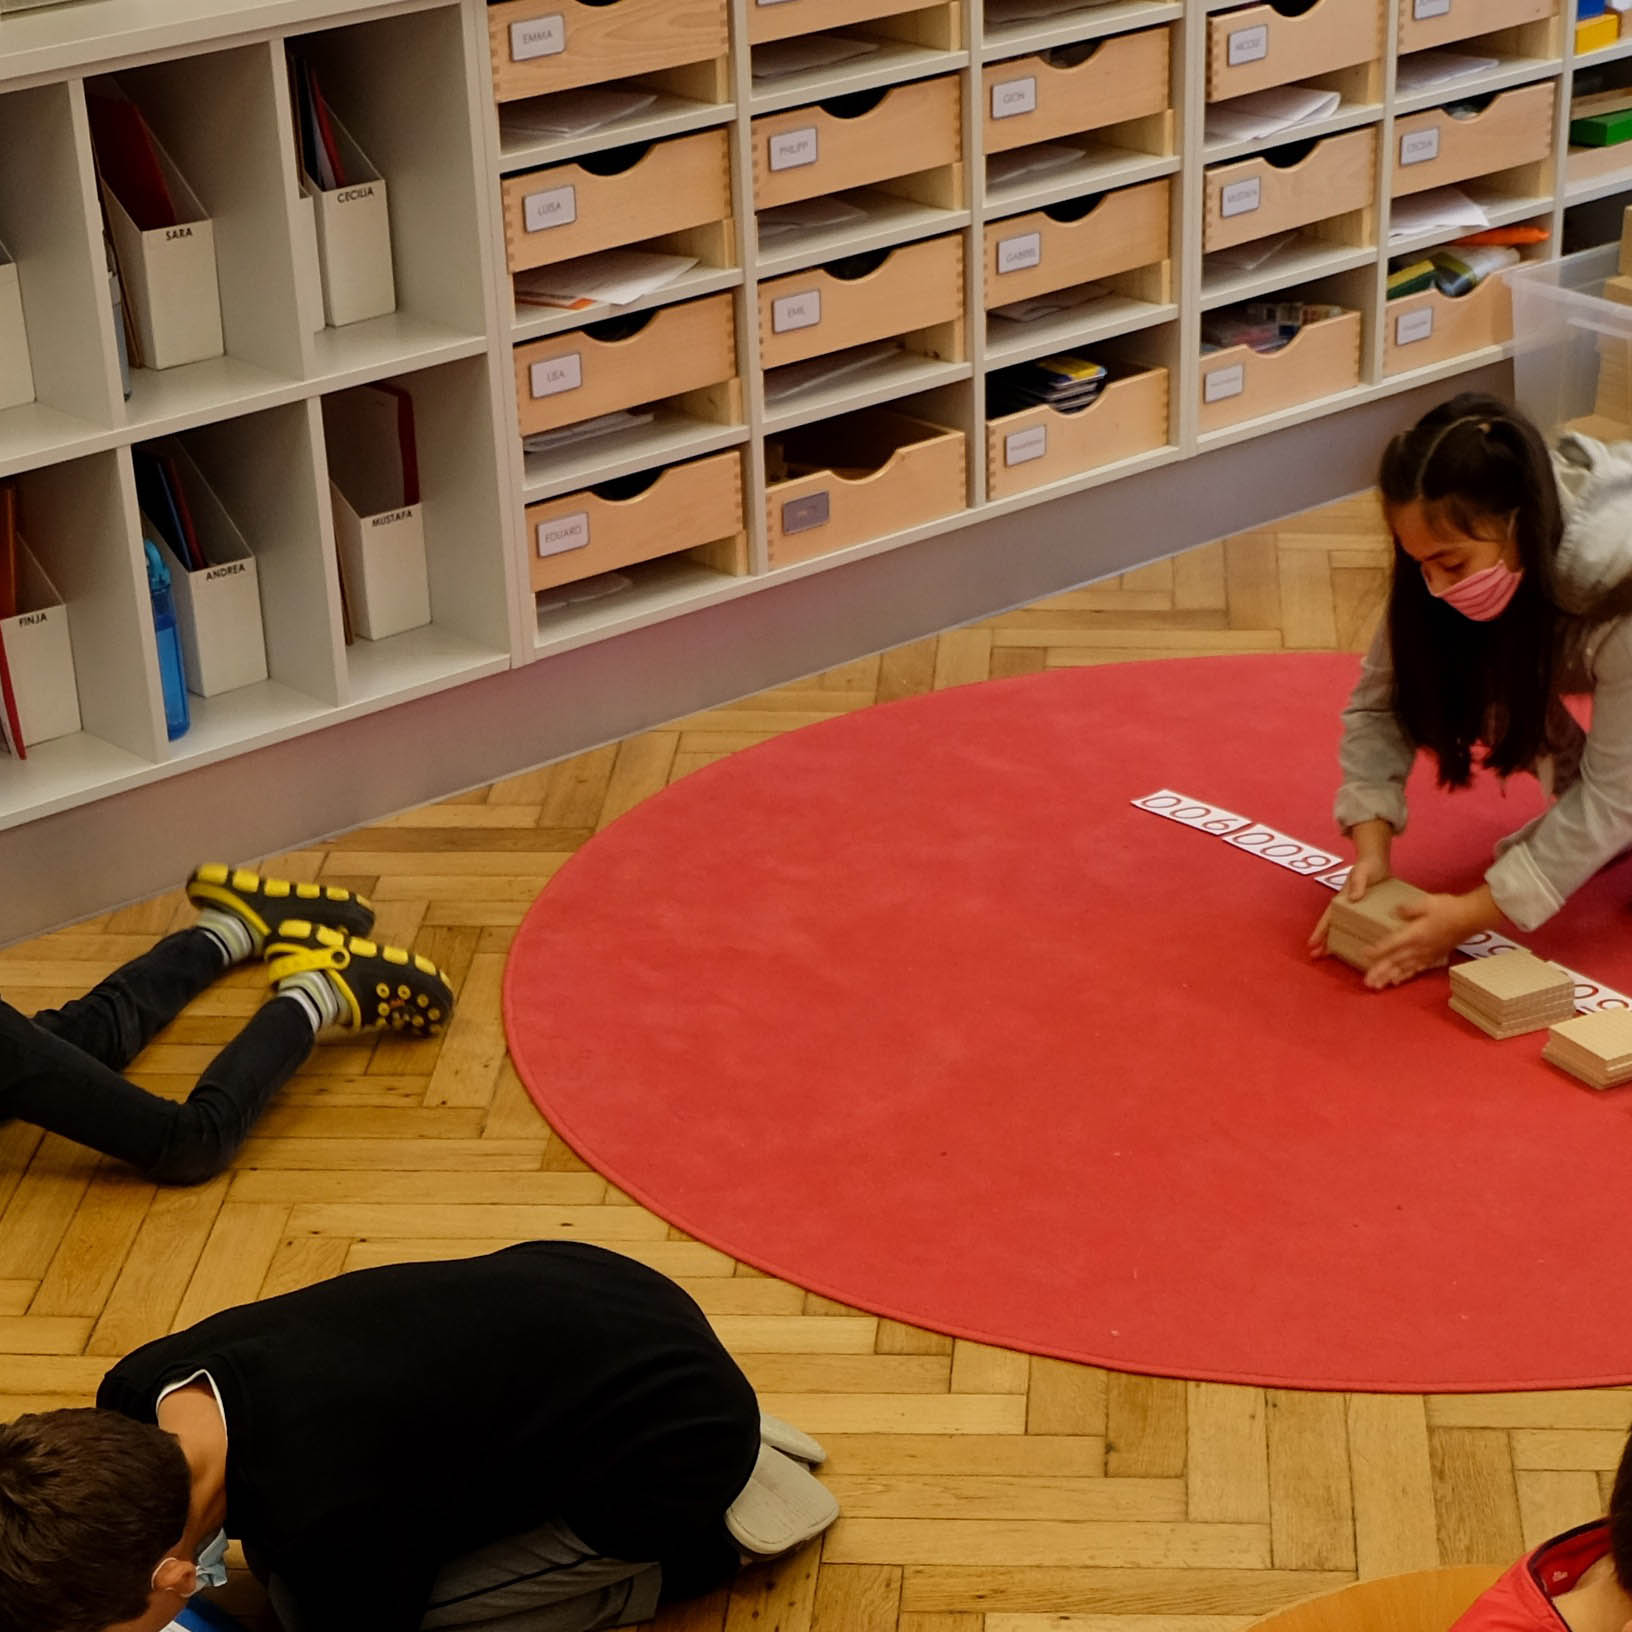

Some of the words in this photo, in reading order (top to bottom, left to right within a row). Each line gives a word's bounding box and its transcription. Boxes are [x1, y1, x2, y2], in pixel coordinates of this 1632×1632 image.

[336, 185, 374, 204] CECILIA
[164, 226, 192, 241] SARA
[204, 563, 245, 581] ANDREA
[18, 612, 47, 627] FINJA
[1142, 795, 1237, 832] 900
[1231, 831, 1332, 871] 800
